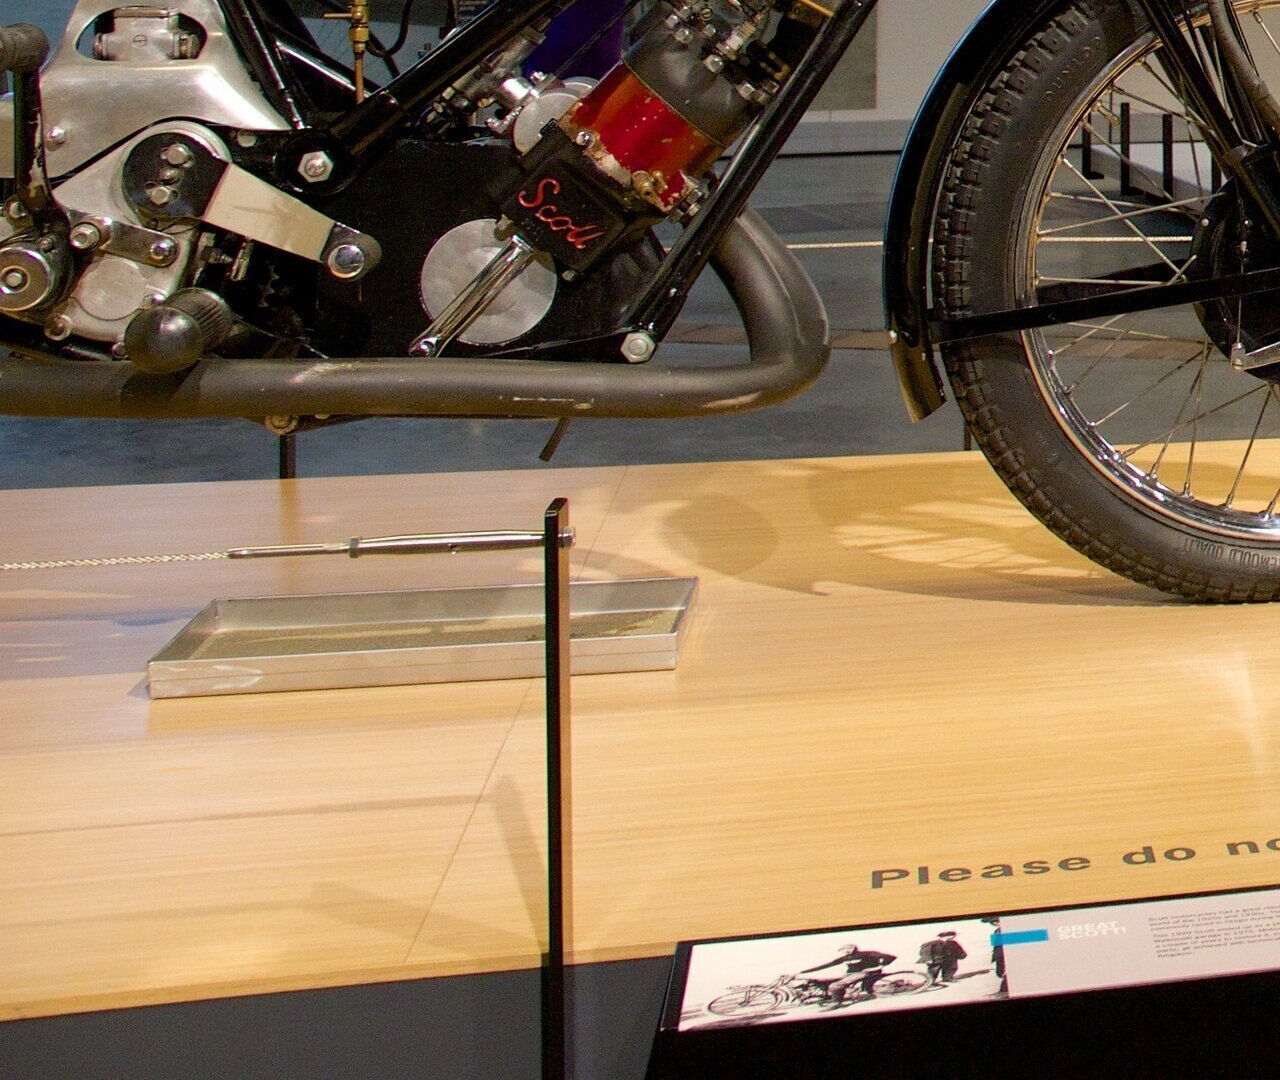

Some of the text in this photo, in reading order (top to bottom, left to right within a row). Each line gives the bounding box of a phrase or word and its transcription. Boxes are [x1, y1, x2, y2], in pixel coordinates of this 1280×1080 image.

[517, 177, 606, 250] Scott
[871, 856, 1091, 889] Please
[1122, 846, 1196, 866] do
